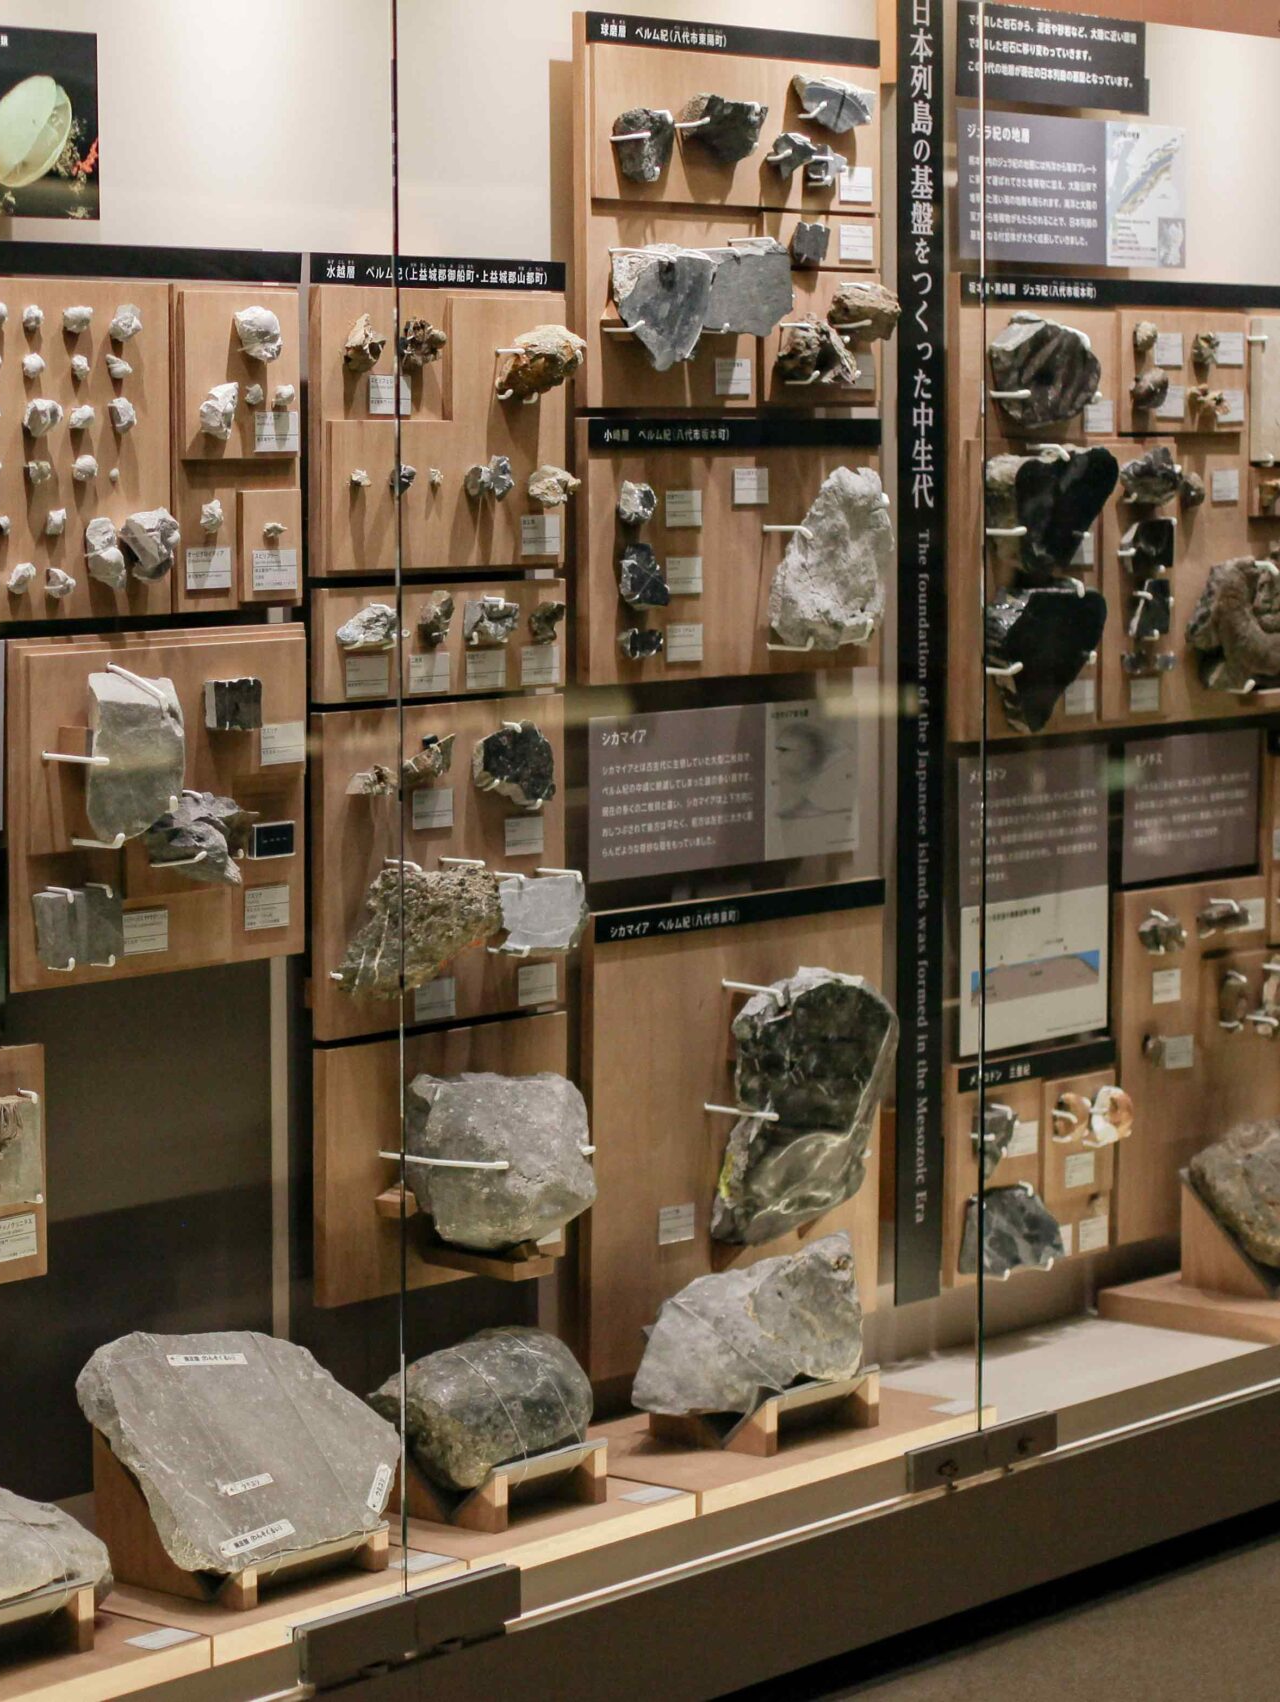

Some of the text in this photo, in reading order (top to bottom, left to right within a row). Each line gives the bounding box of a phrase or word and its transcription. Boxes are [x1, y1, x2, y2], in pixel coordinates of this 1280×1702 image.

[600, 22, 627, 39] 球磨層
[910, 0, 934, 509] 日本列島の基盤をつくった中生代
[327, 264, 356, 279] 水越層
[918, 529, 930, 565] The
[917, 571, 930, 679] foundation
[918, 686, 930, 706] of
[602, 730, 647, 746] シカマイア
[918, 714, 930, 743] the
[916, 749, 930, 836] Japanese
[610, 921, 649, 939] シカマイア
[917, 916, 927, 952] was
[917, 961, 929, 1028] formed
[916, 1035, 927, 1053] in
[916, 1060, 928, 1090] the
[915, 1097, 928, 1185] Mesozoic
[915, 1191, 927, 1223] Era
